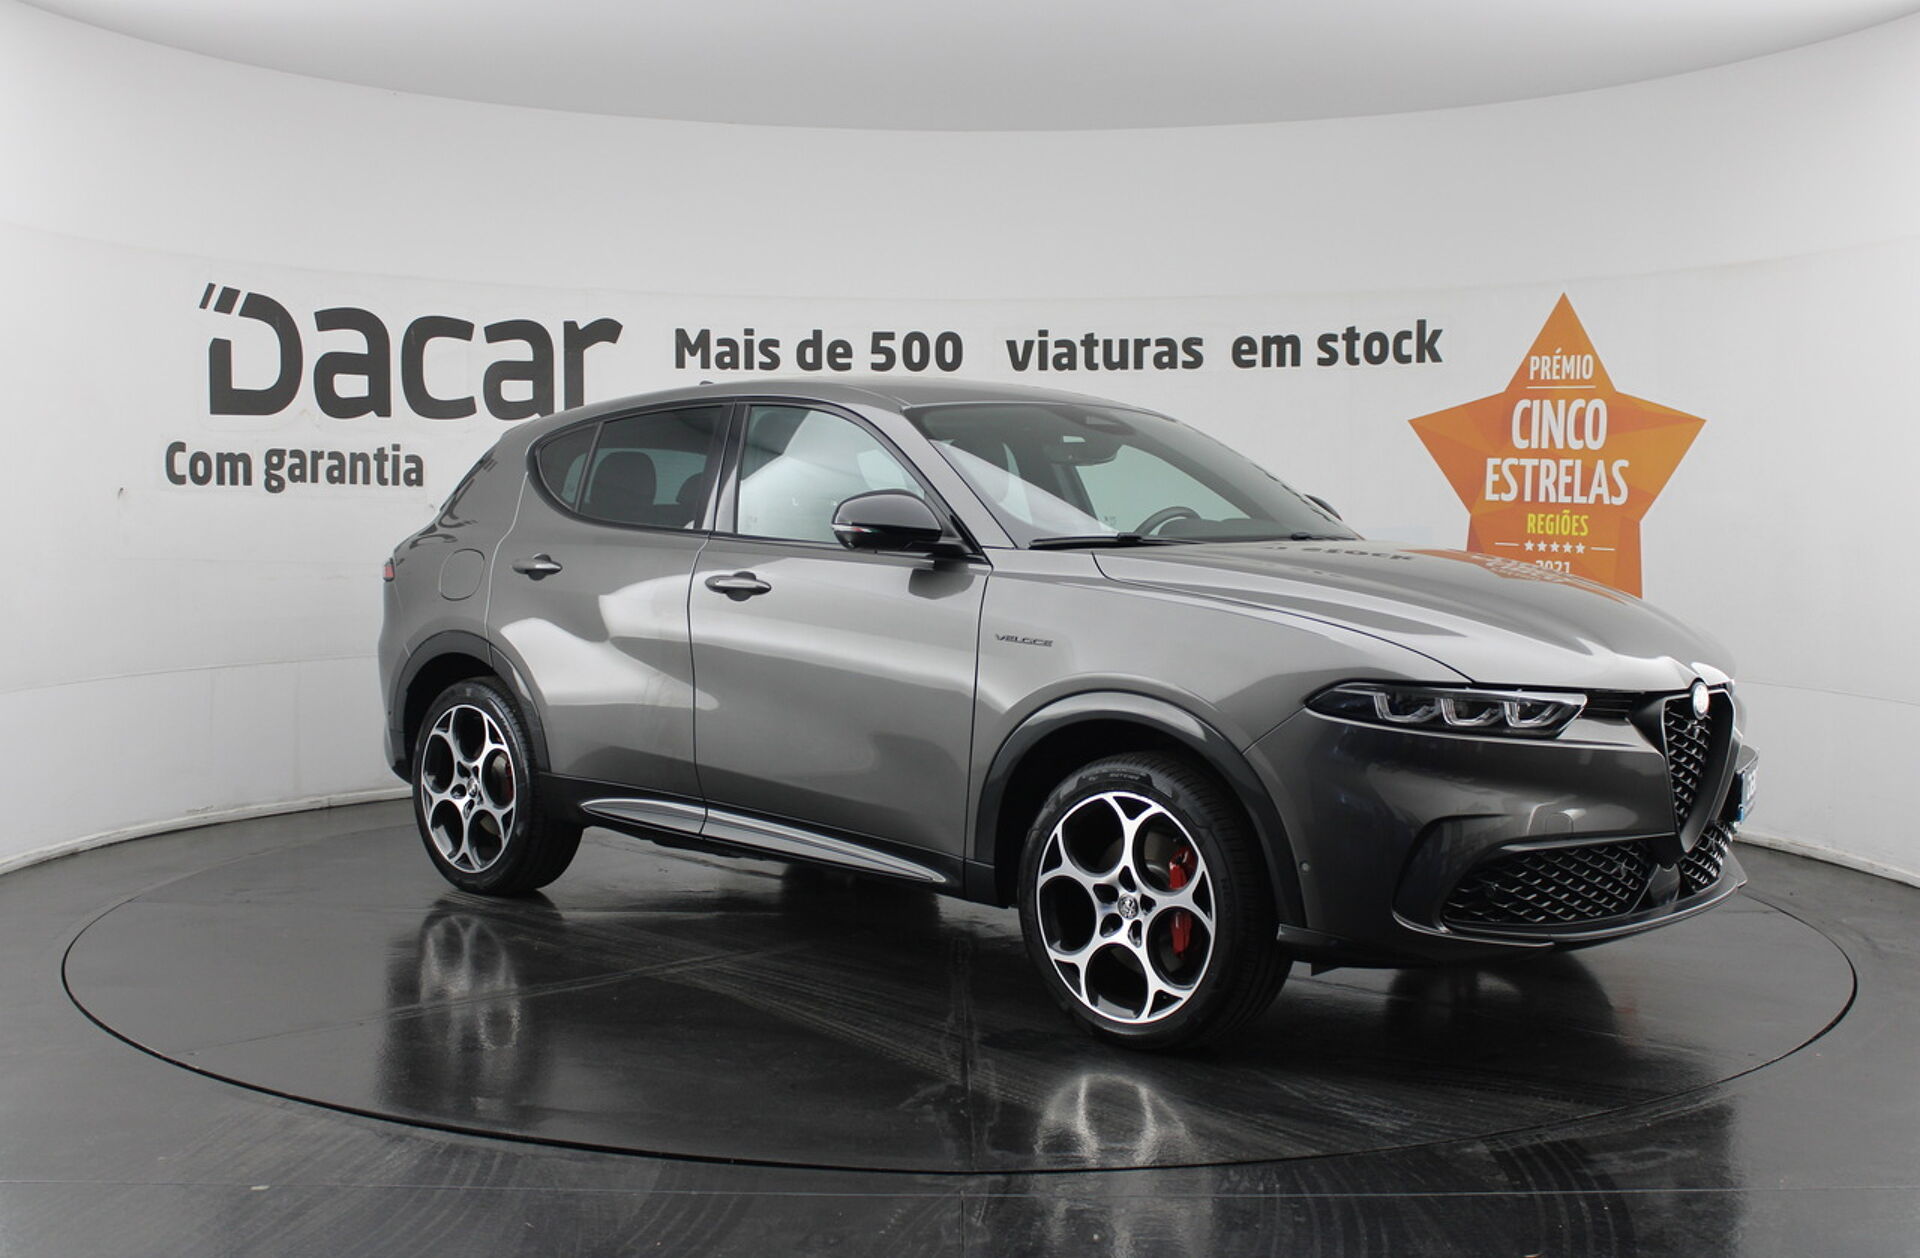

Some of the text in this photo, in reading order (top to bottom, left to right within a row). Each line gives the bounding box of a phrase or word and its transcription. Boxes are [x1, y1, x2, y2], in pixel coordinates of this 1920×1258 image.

[199, 282, 624, 421] Dacar
[674, 318, 1443, 373] Mais de 500 viaturas em stock
[1529, 347, 1594, 381] PRÉMIO
[1511, 398, 1608, 451] CINCO
[165, 441, 425, 494] Com garantia
[1484, 457, 1630, 506] ESTRELAS
[1526, 509, 1589, 537] REGIÕES
